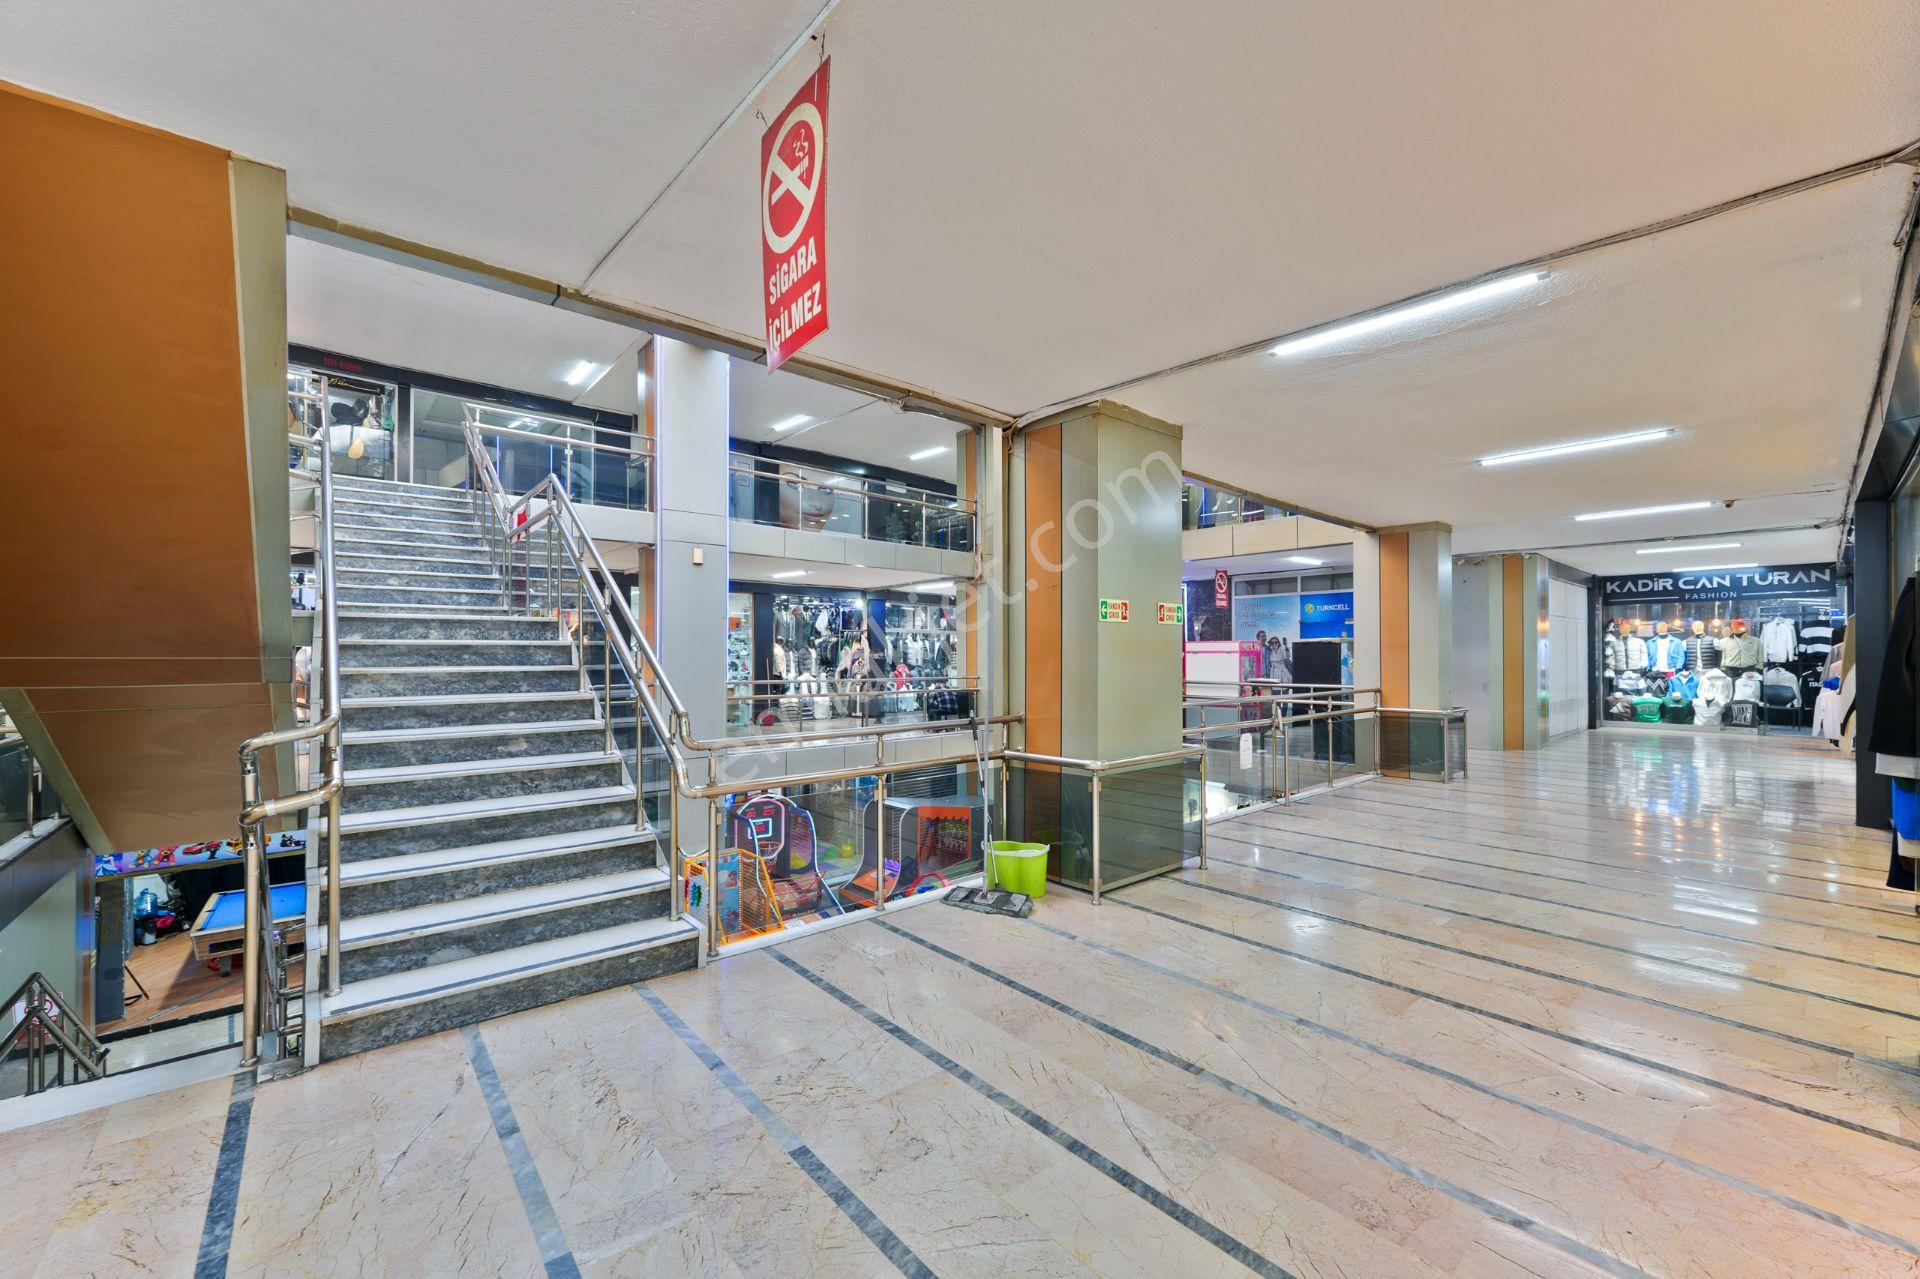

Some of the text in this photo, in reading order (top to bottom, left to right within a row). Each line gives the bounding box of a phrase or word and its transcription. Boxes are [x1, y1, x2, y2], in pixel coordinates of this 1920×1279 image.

[769, 236, 817, 304] SİGARA
[769, 281, 822, 354] İÇİLMEZ
[1606, 569, 1830, 593] KADİR CAN TURAN
[1315, 603, 1350, 612] TURKCELL
[1685, 592, 1737, 600] FASHION
